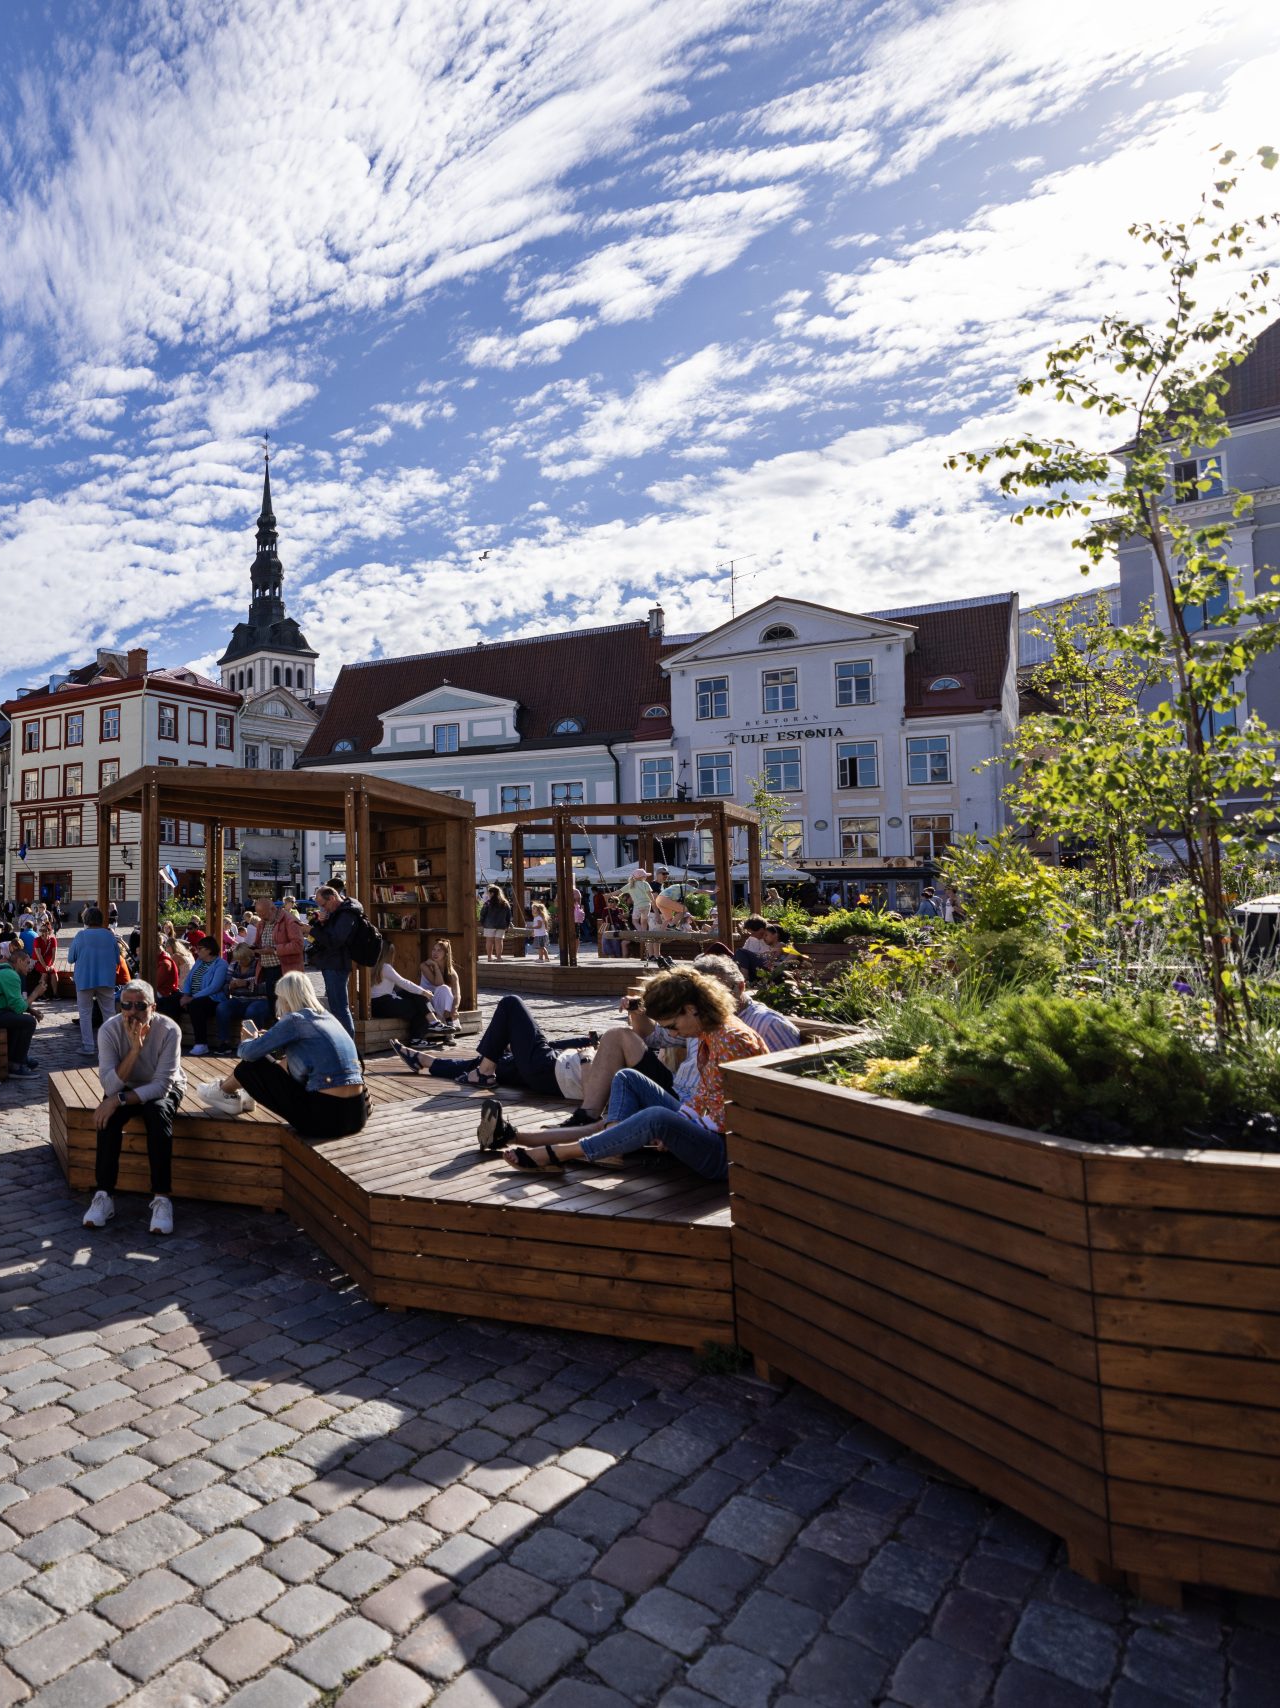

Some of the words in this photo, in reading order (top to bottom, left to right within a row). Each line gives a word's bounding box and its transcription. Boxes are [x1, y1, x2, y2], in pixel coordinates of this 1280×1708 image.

[745, 714, 819, 727] RESTORAN
[777, 727, 844, 741] ESTONIA
[643, 813, 672, 821] GRILL
